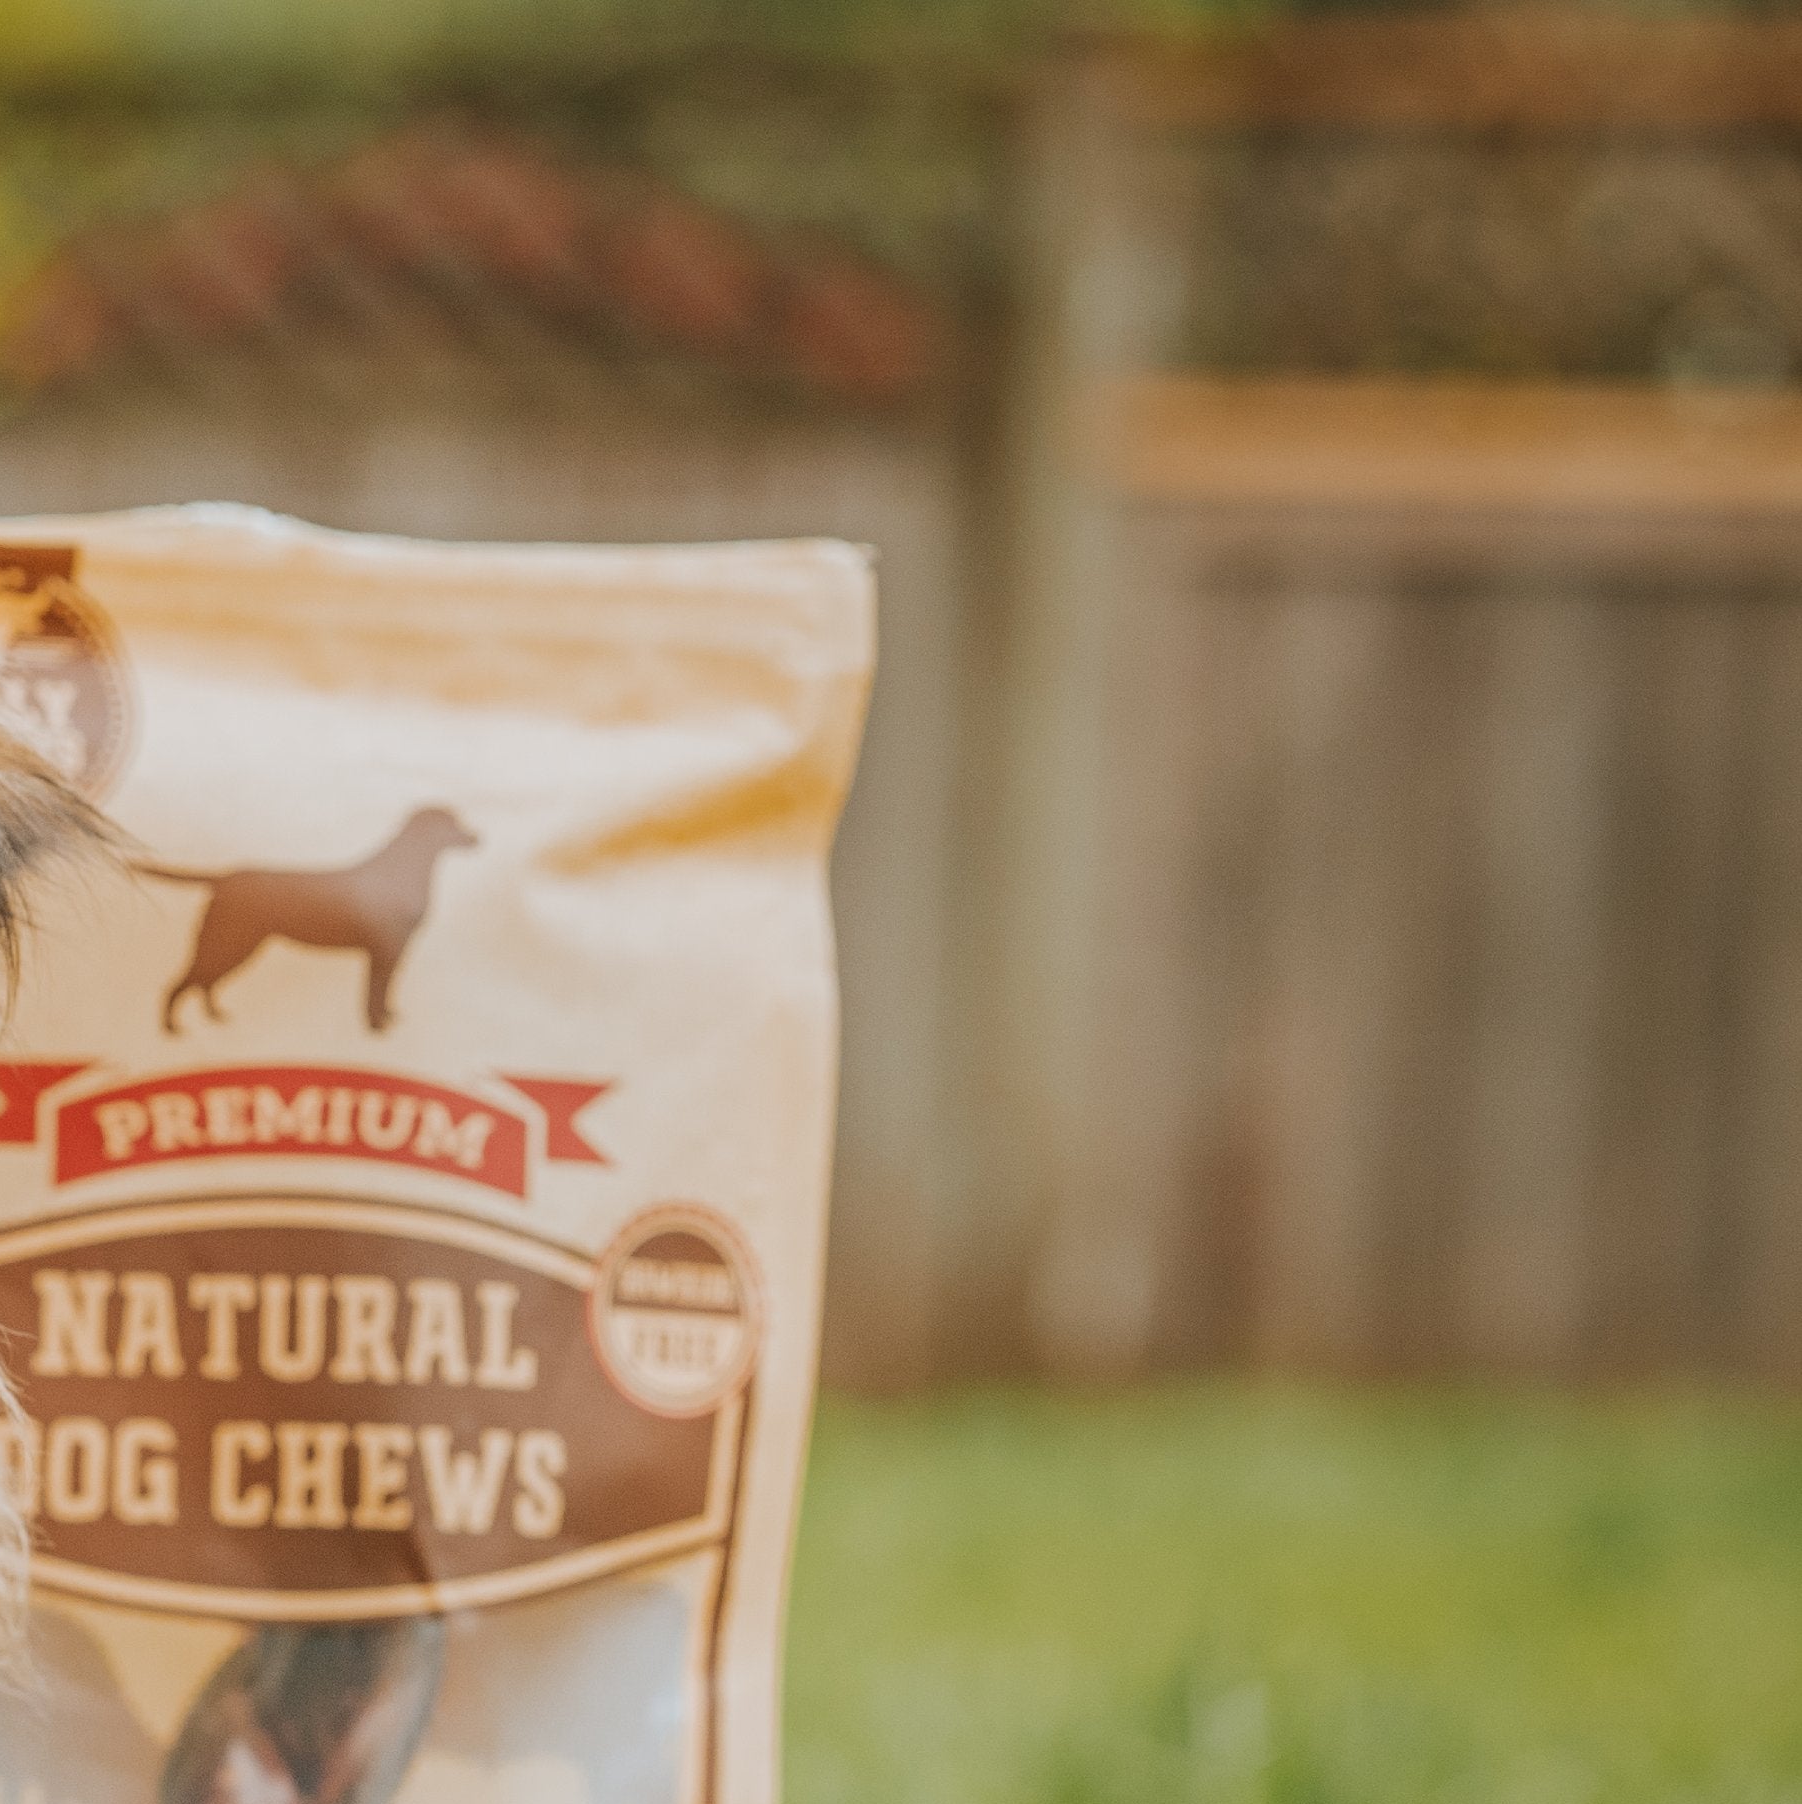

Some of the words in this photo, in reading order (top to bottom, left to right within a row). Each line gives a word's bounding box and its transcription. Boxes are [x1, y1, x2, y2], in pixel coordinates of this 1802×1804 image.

[97, 1084, 493, 1169] PREMIUM
[31, 1270, 538, 1389] NATURAL
[211, 1420, 567, 1539] CHEWS
